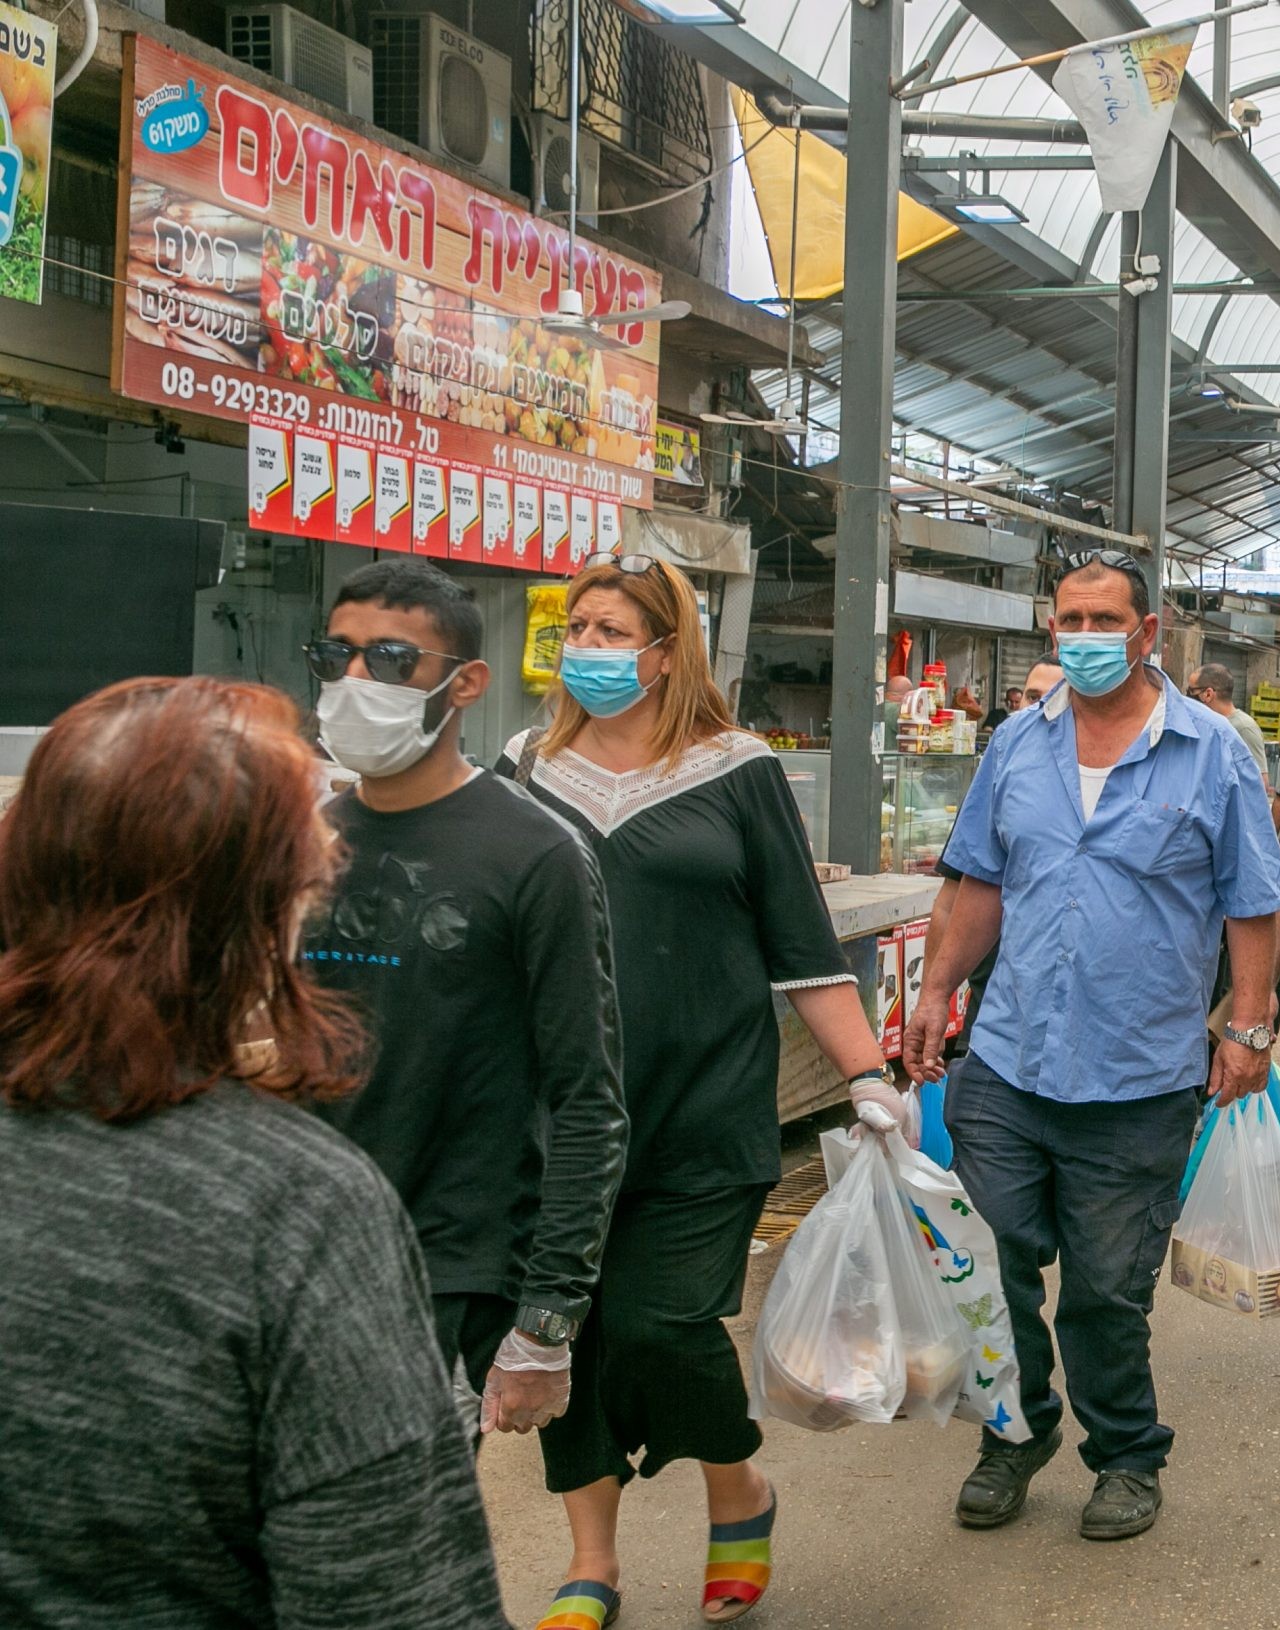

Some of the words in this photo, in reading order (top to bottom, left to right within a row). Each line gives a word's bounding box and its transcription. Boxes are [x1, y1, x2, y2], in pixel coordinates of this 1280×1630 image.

[458, 39, 484, 64] ELCO
[216, 84, 437, 272] האחים
[154, 216, 239, 293] דגים
[138, 279, 248, 345] מעושנים
[281, 288, 379, 361] סלטים
[161, 362, 310, 424] 08-9293329
[492, 443, 508, 469] 11
[583, 461, 616, 494] רמלה
[620, 474, 643, 501] שוק
[303, 950, 401, 967] HERITAGE
